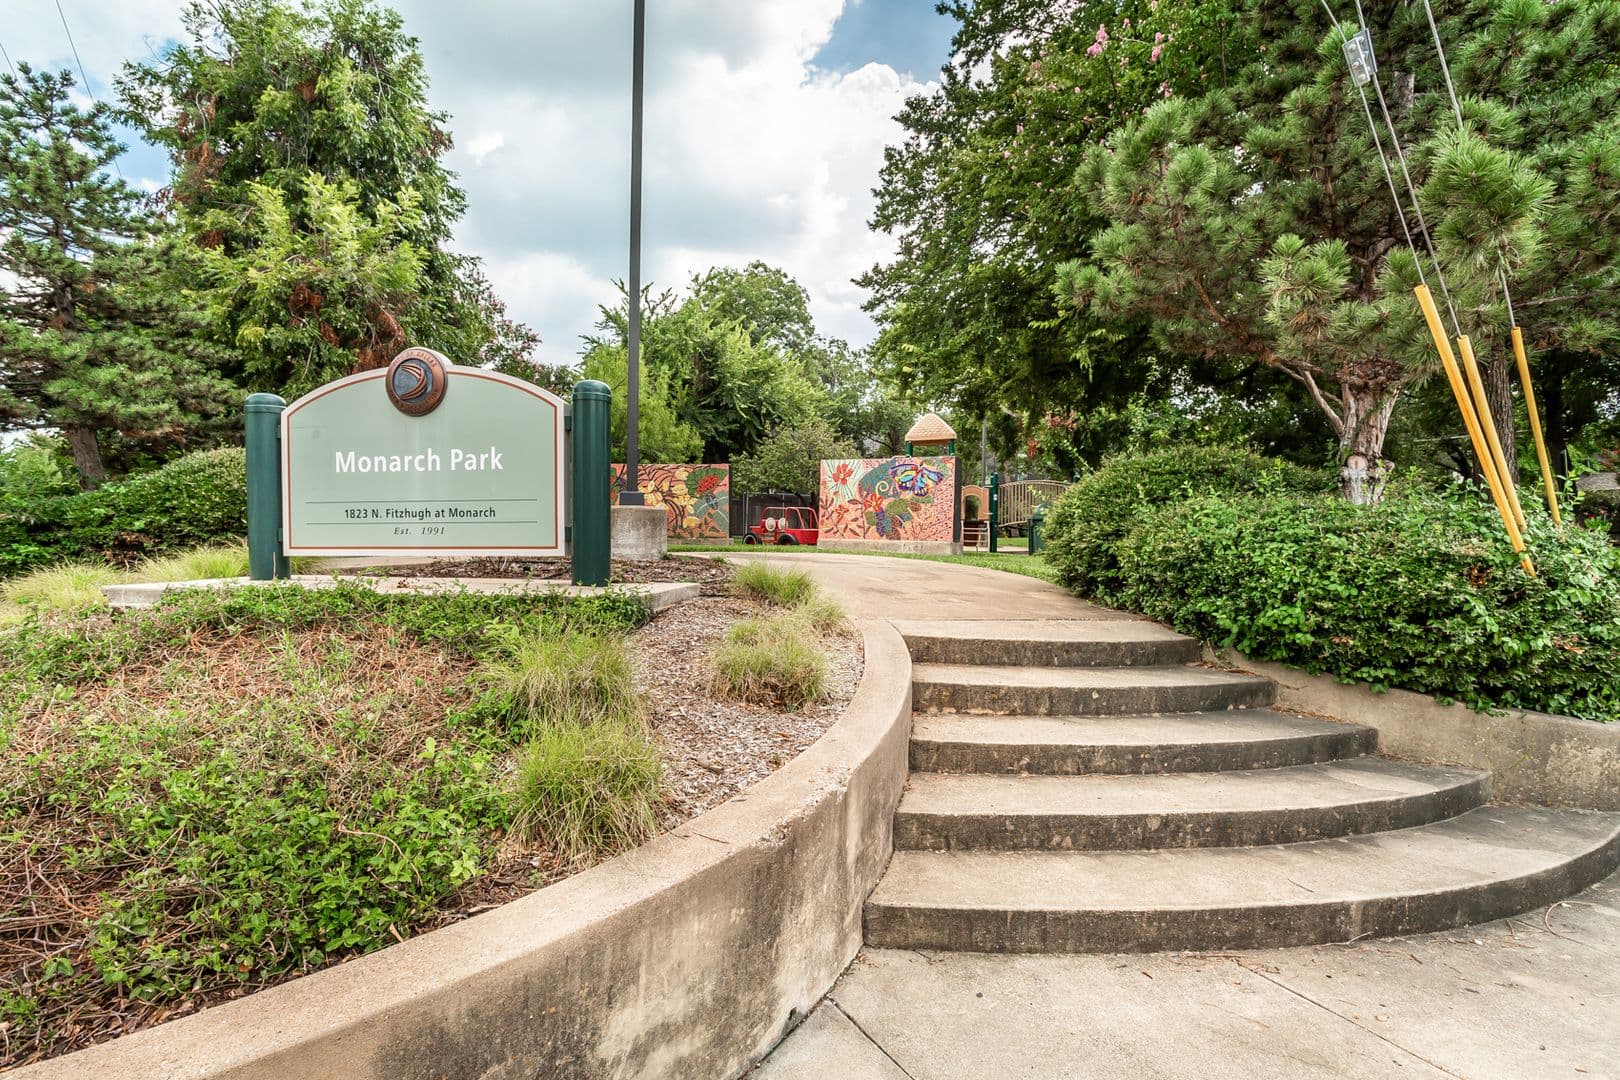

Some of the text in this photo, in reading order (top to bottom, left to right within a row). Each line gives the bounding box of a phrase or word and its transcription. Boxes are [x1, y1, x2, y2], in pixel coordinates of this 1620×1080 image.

[335, 445, 504, 473] Monarch Park
[344, 506, 496, 521] 1823 N. Fitzhugh at Monarch
[393, 526, 446, 536] Est. 1991
